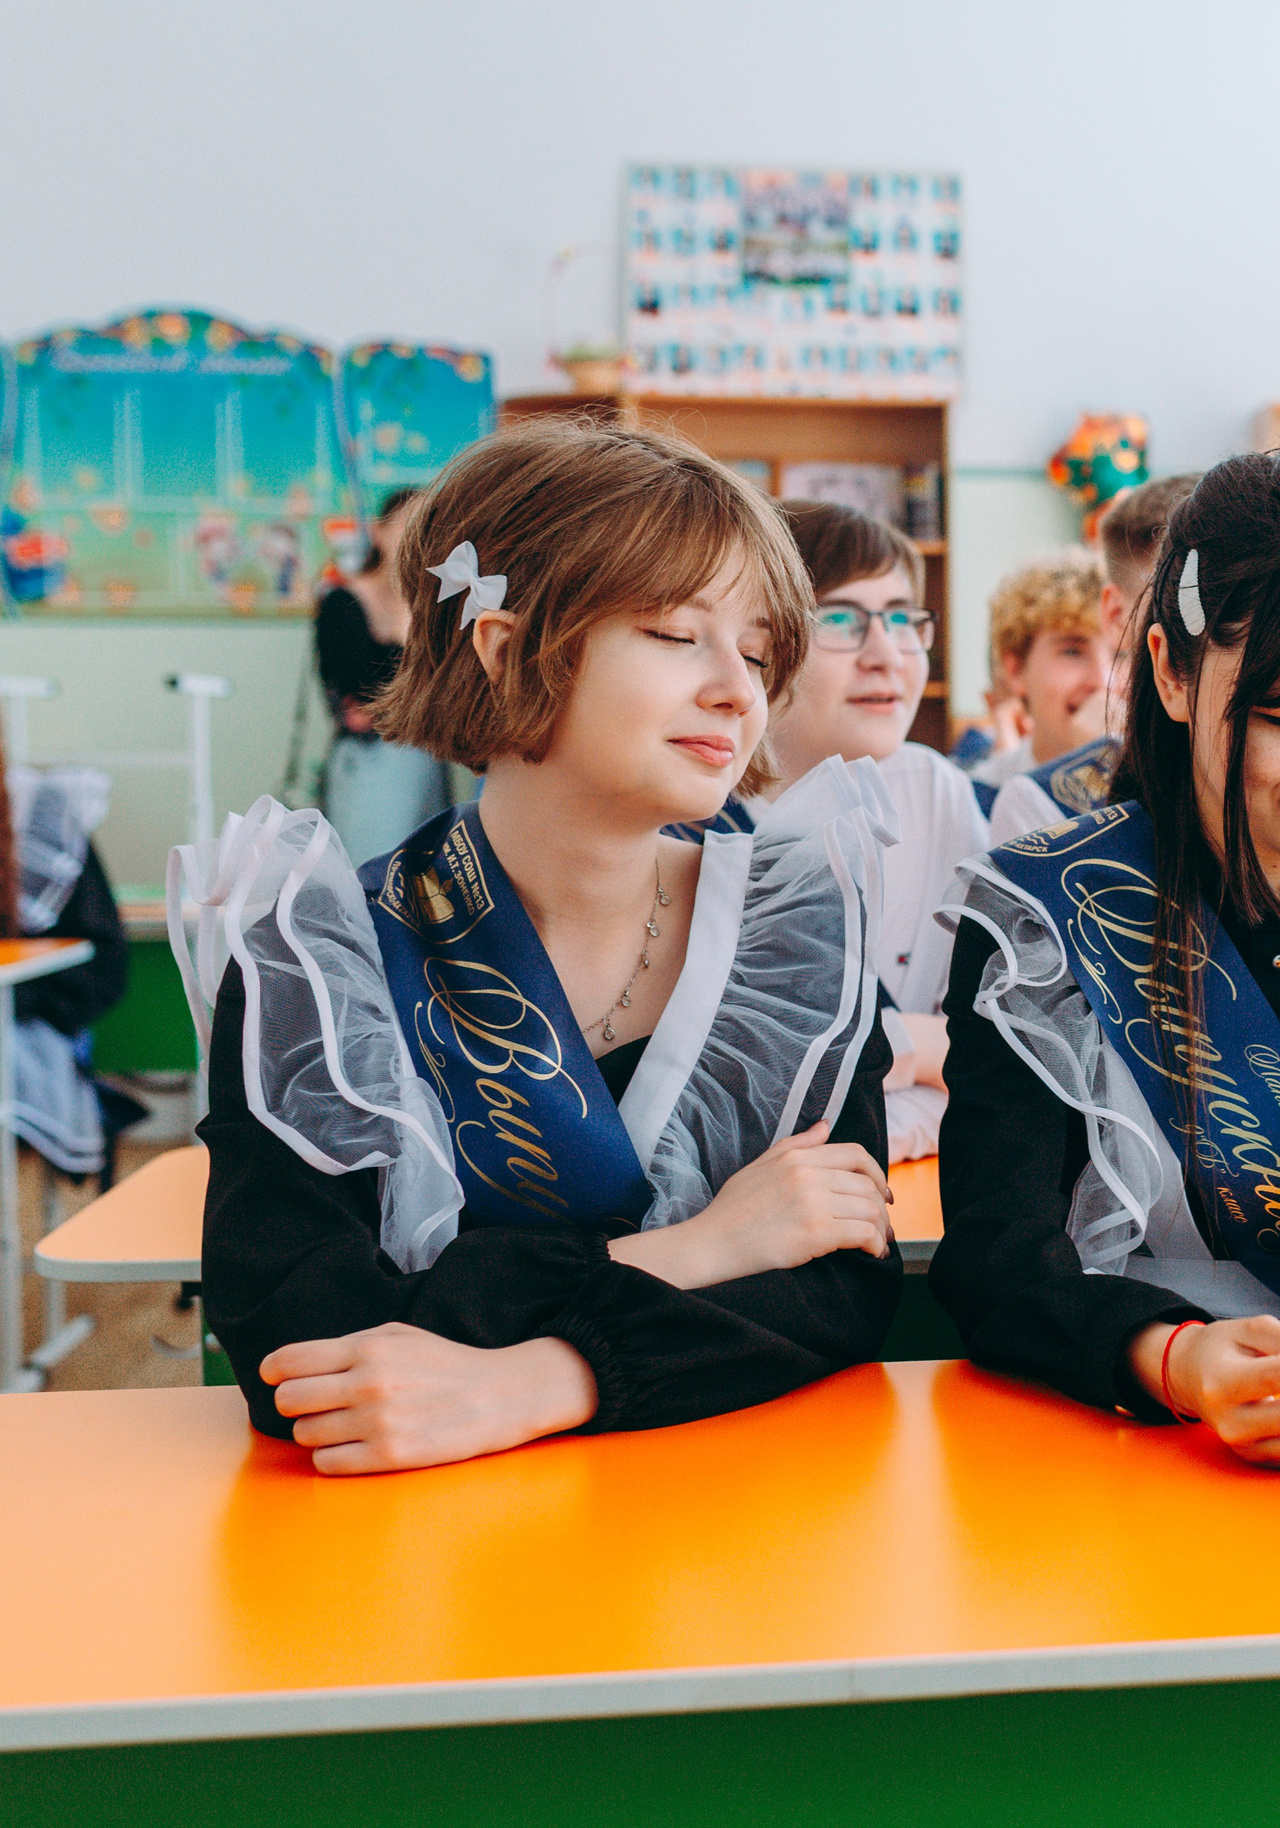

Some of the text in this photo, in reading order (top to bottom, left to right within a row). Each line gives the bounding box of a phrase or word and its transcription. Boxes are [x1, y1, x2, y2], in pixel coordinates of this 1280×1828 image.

[451, 830, 485, 910] МБОУ СОШ №13
[423, 956, 588, 1225] Выпу
[1217, 1187, 1248, 1223] класс
